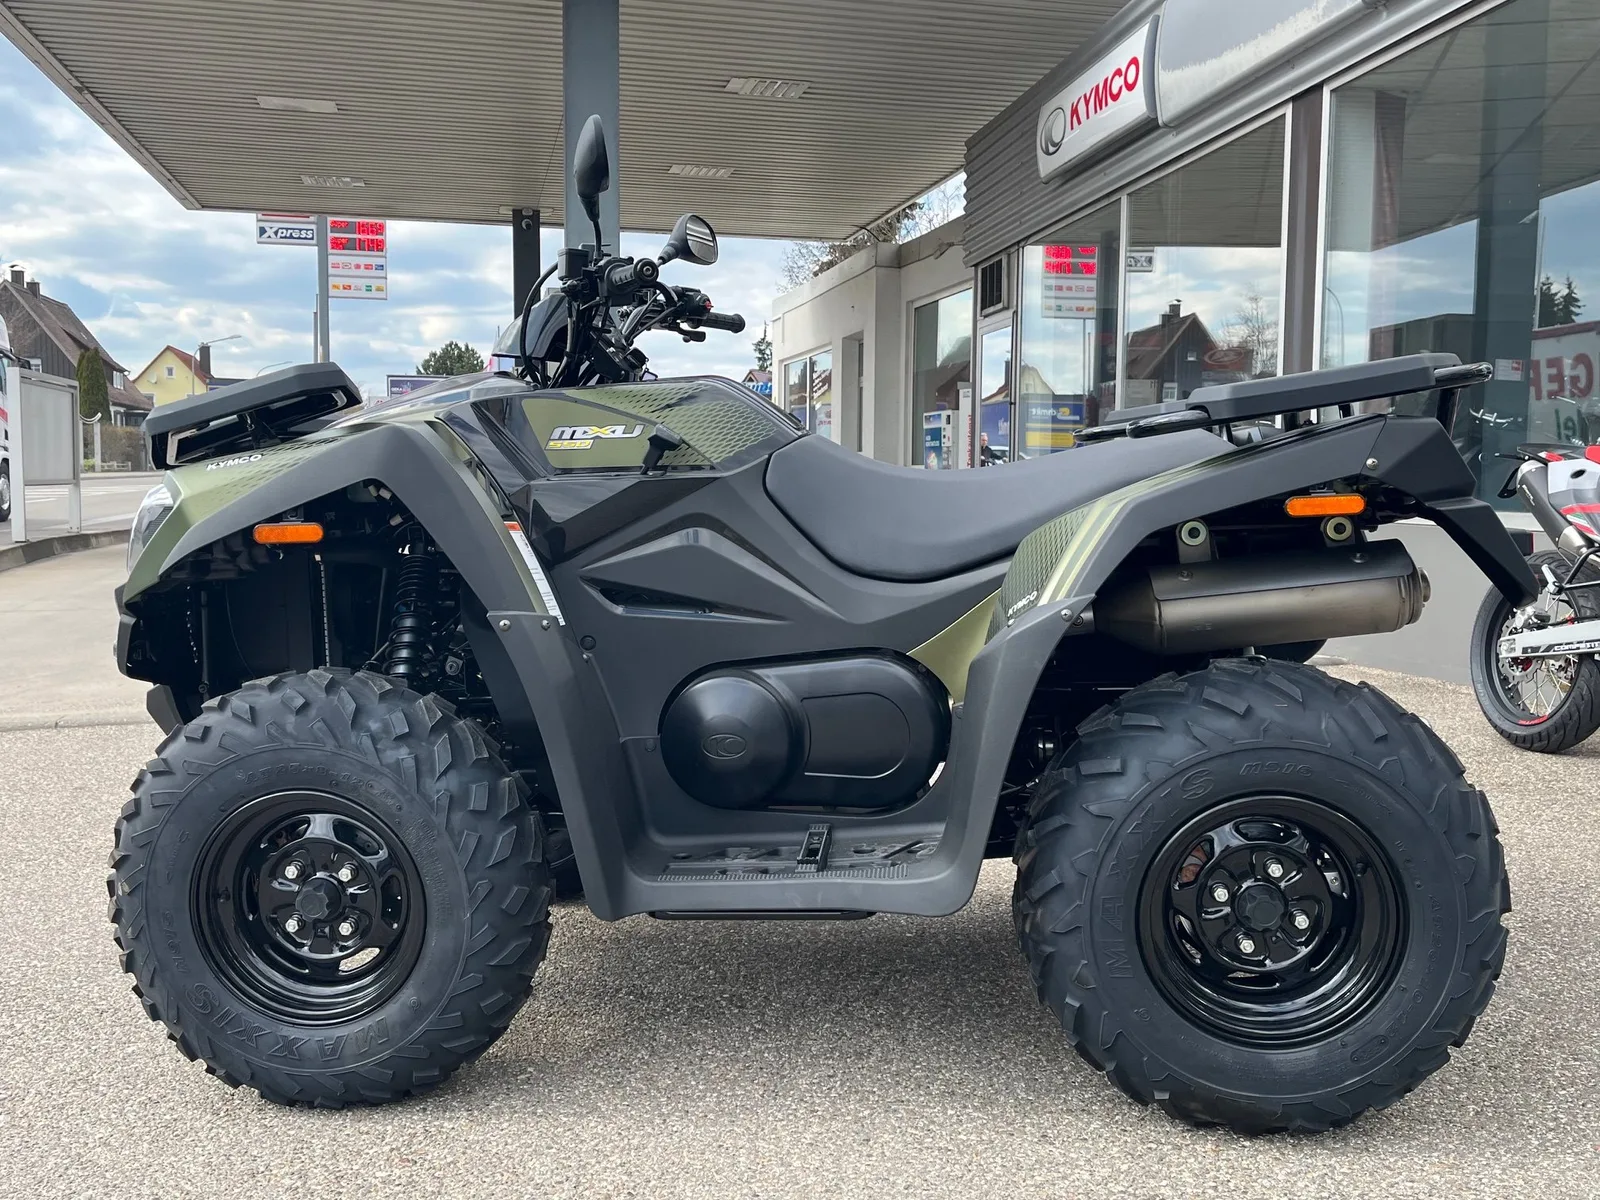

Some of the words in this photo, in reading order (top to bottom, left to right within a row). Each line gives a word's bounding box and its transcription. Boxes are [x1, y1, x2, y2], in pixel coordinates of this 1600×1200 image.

[1069, 56, 1140, 131] KYMCO
[260, 226, 315, 240] Xpress
[549, 424, 645, 440] MXU
[548, 440, 592, 449] 550
[206, 454, 262, 471] KYMCO
[1007, 590, 1038, 618] KYMCO
[1099, 766, 1216, 980] MAXXIS
[186, 980, 391, 1063] MAXXIS
